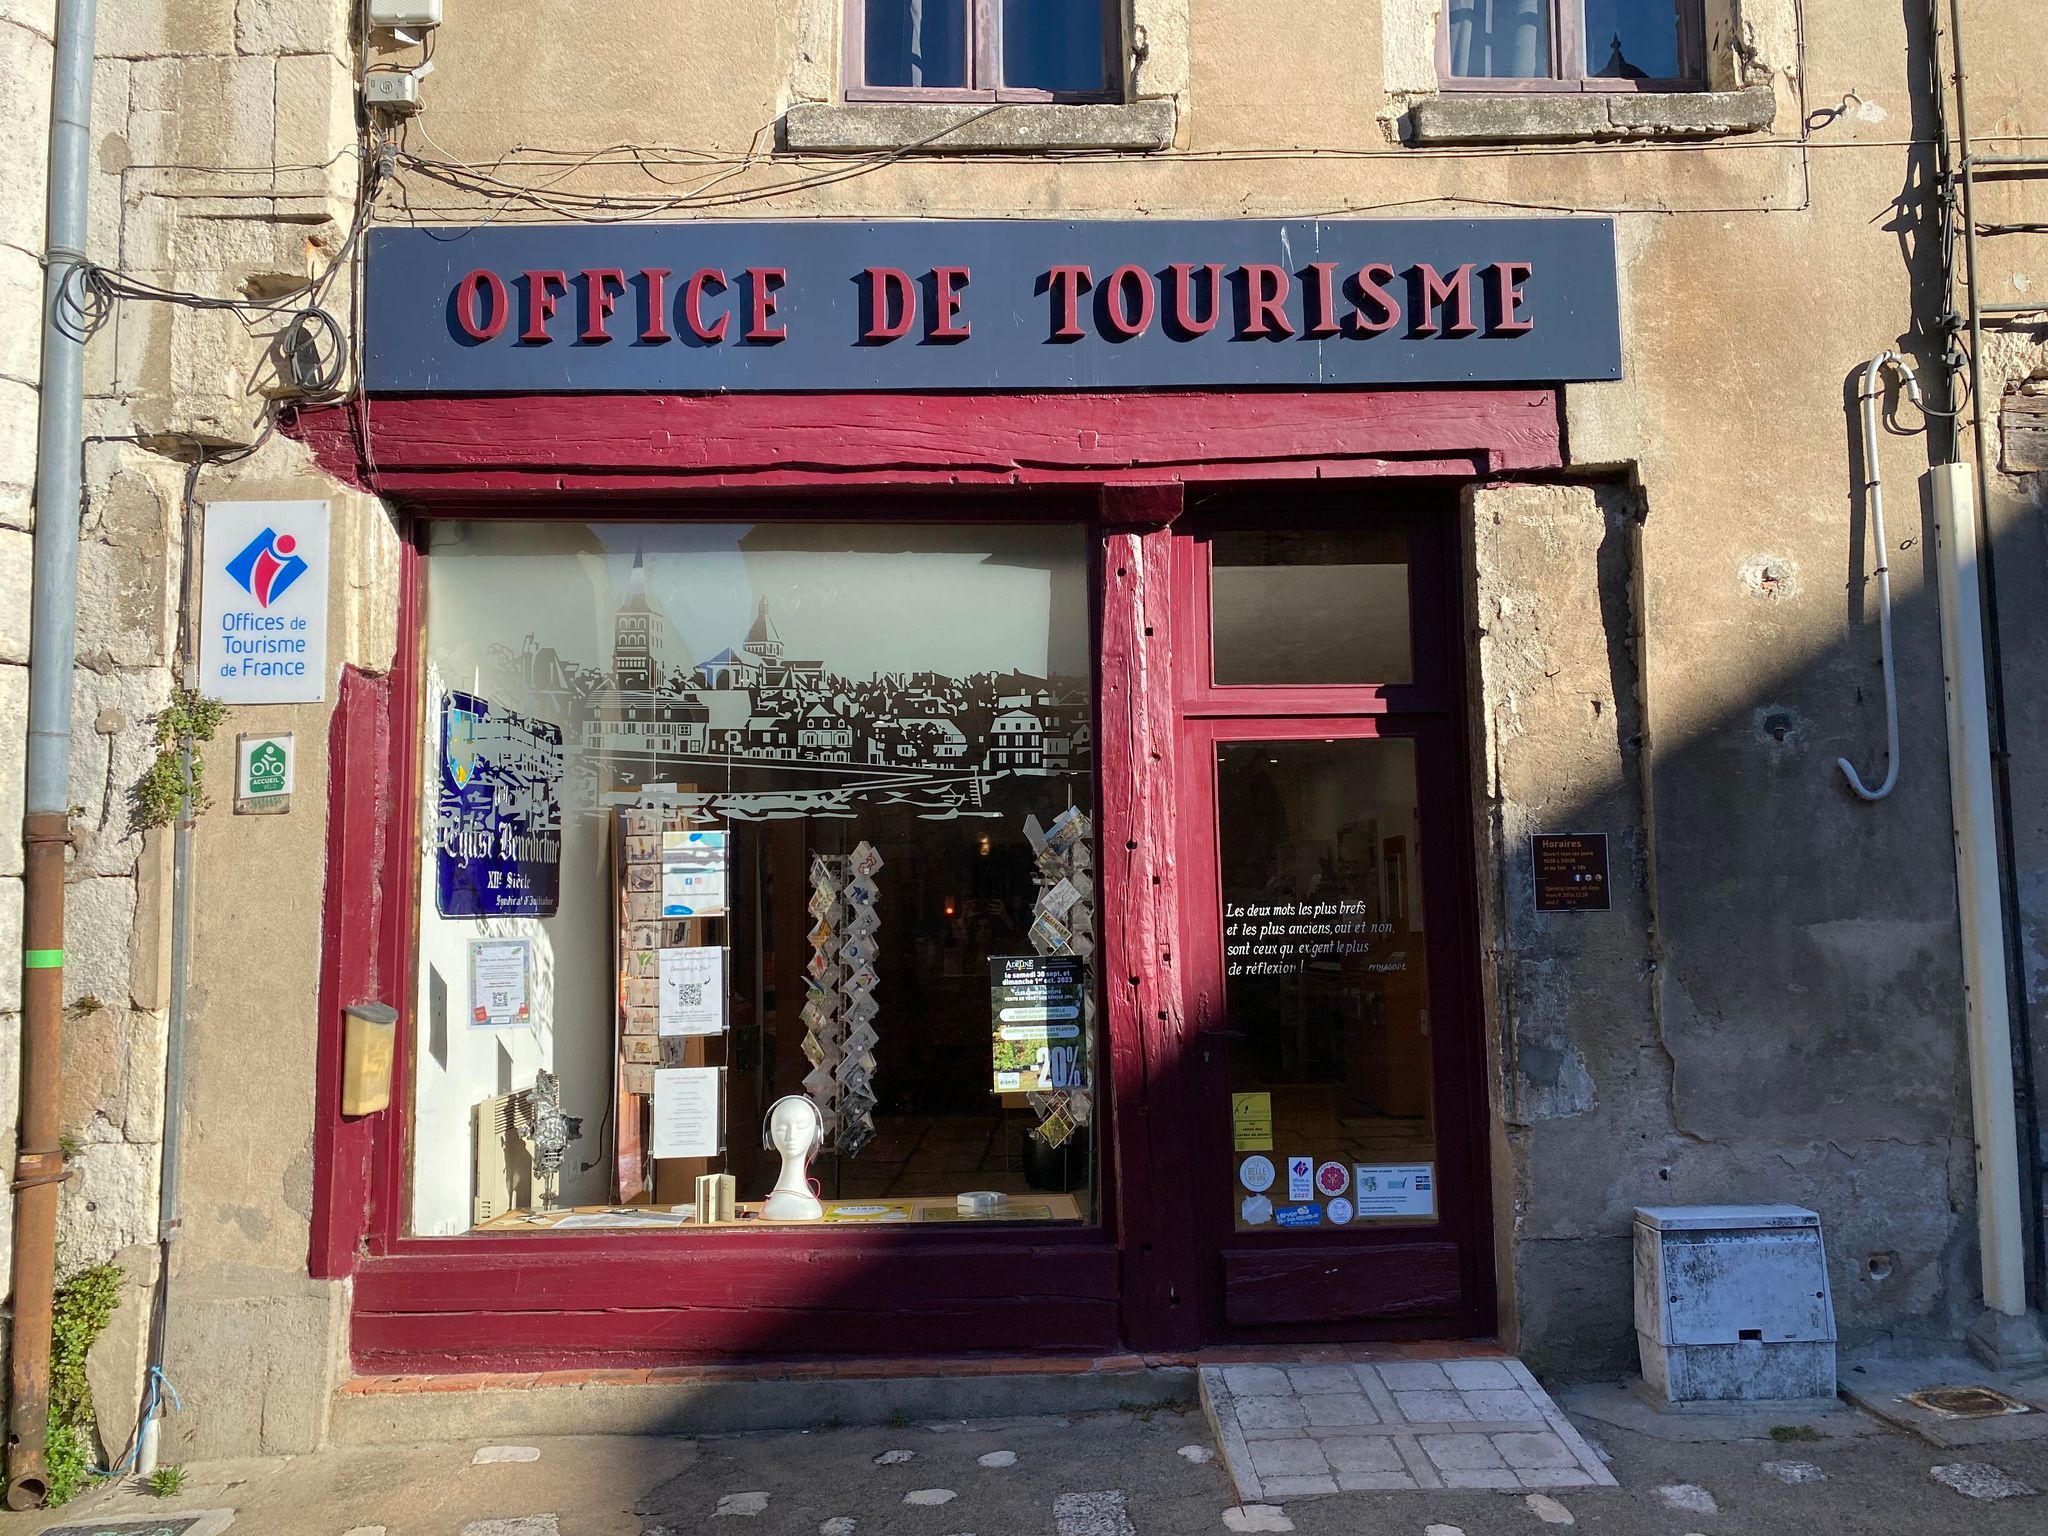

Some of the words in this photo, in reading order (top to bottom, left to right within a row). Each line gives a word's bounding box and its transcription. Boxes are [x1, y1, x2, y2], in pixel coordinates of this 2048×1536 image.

[456, 267, 787, 343] OFFICE
[862, 265, 972, 338] DE
[1048, 261, 1535, 337] TOURISME
[222, 612, 285, 631] Offices
[290, 616, 307, 630] de
[222, 635, 306, 654] Tourisme
[220, 663, 237, 677] de
[243, 657, 305, 676] France
[252, 777, 280, 786] ACCUEIL
[1542, 840, 1582, 849] Horaires
[506, 871, 531, 889] Siècle
[496, 894, 523, 910] Syndicat
[1226, 903, 1245, 918] Les
[1247, 904, 1271, 917] deux
[1273, 902, 1296, 916] mots
[1299, 902, 1313, 915] les
[1313, 901, 1337, 919] plus
[1339, 900, 1366, 916] brefs
[1226, 923, 1239, 936] et
[1242, 923, 1257, 936] les
[1259, 921, 1286, 941] plus
[1354, 921, 1366, 934] et
[1227, 942, 1250, 956] sont
[1253, 944, 1278, 955] ceux
[1279, 944, 1297, 959] qu
[1336, 940, 1346, 953] le
[1345, 940, 1370, 957] plus
[1004, 971, 1012, 979] le
[1012, 970, 1036, 979] samedi
[1036, 970, 1046, 978] 30
[1046, 970, 1063, 978] sept.
[1228, 962, 1242, 976] de
[1245, 961, 1297, 975] réflexion
[1001, 978, 1034, 986] dimanche
[1056, 975, 1073, 984] 2023
[1036, 1046, 1080, 1088] 20%
[1247, 1167, 1267, 1176] BELLE
